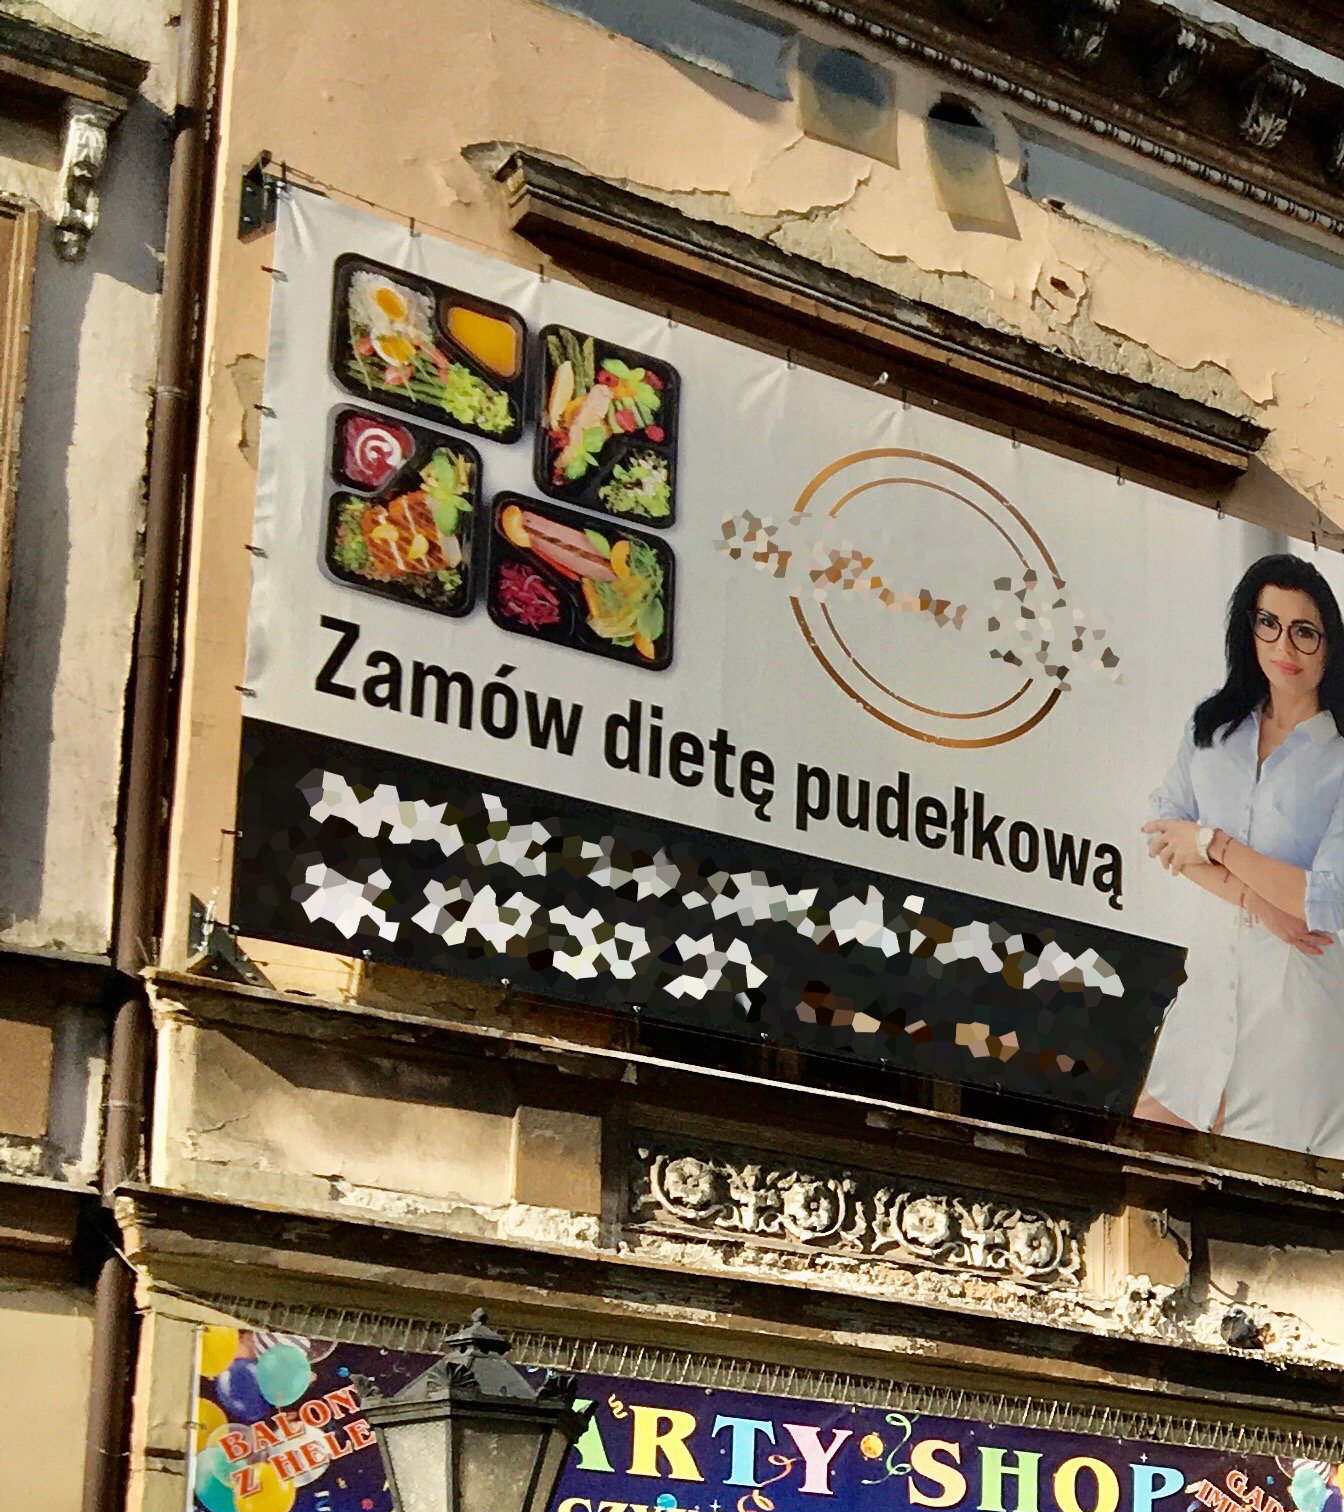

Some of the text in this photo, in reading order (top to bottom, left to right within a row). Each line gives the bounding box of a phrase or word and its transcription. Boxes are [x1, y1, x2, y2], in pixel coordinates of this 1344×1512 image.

[313, 614, 584, 757] Zamów
[602, 697, 776, 824] dietę
[795, 759, 1126, 912] pudełkową
[219, 1383, 362, 1464] BALON
[230, 1418, 378, 1498] Z HELE
[570, 1398, 854, 1496] ARTY
